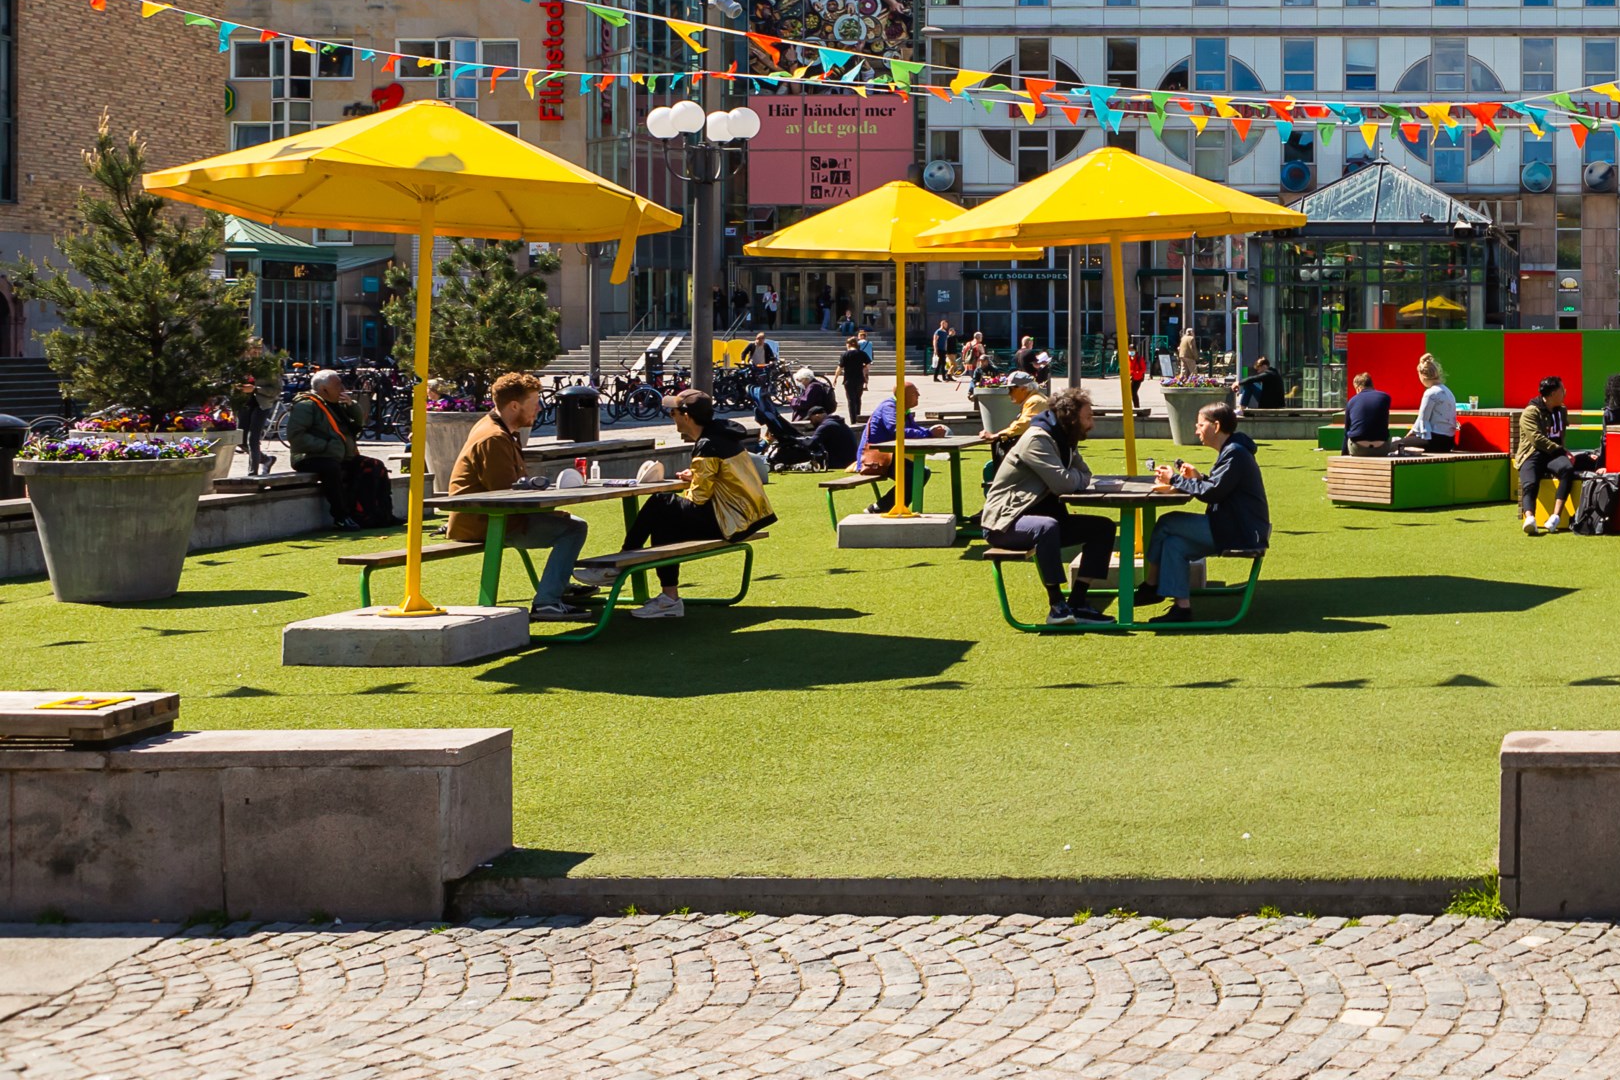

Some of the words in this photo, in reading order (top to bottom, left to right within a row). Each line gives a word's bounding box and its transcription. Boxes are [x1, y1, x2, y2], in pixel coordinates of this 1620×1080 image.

[768, 104, 798, 117] Här
[804, 103, 860, 117] händer
[865, 106, 896, 117] mer
[786, 123, 803, 134] av
[808, 120, 833, 134] det
[837, 120, 878, 138] goda
[1464, 200, 1535, 226] ALL
